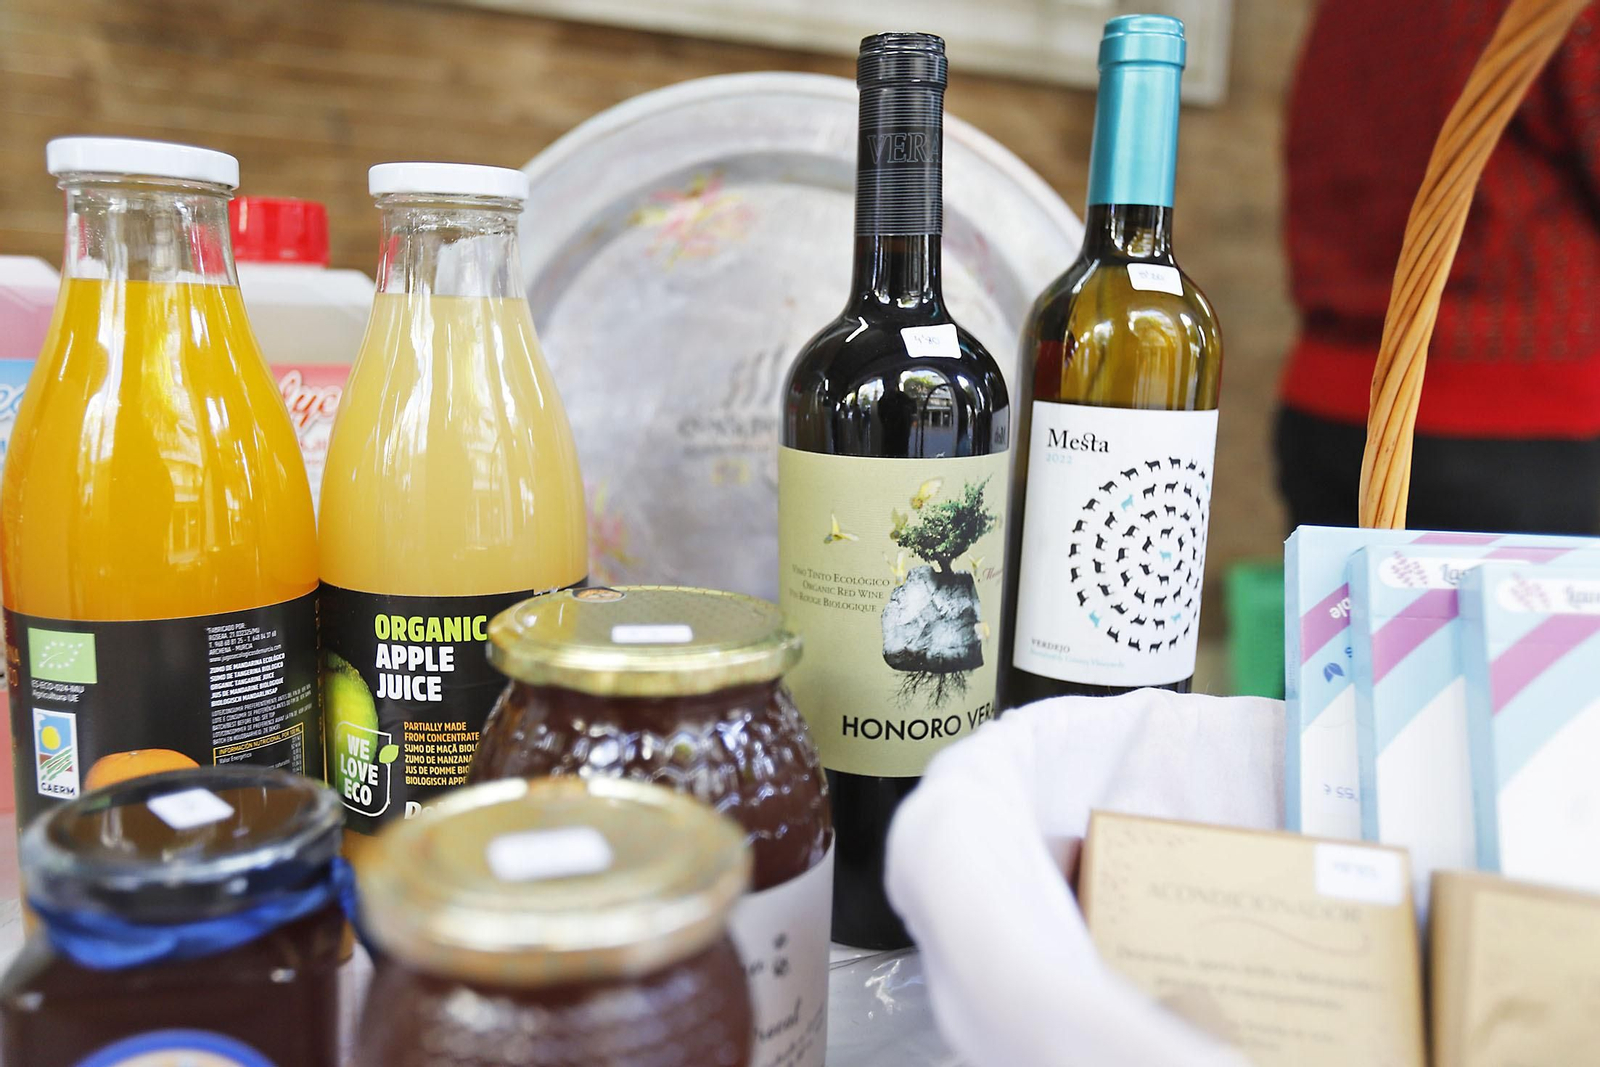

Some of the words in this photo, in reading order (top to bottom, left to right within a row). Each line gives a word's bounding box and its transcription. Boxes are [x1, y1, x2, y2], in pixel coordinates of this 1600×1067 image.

[1048, 428, 1110, 452] Mesta
[1046, 453, 1072, 464] 2022
[374, 614, 488, 642] ORGANIC
[1031, 639, 1070, 653] VERDEJO
[376, 643, 454, 672] APPLE
[210, 666, 225, 674] ZUMO
[233, 659, 262, 669] MANDARINA
[210, 681, 234, 691] ORGANIC
[262, 672, 275, 680] JUICE
[376, 673, 442, 702] JUICE
[32, 689, 68, 701] Agricultura
[404, 722, 442, 732] PARTIALLY
[444, 722, 466, 731] MADE
[842, 715, 961, 740] HONORO
[967, 702, 995, 730] VER
[219, 742, 252, 755] INFORMACIÓN
[253, 735, 282, 747] NUTRICIONAL
[404, 732, 425, 742] FROM
[427, 732, 480, 742] CONCENTRATE
[348, 734, 370, 760] WE
[405, 743, 424, 753] SUMO
[426, 745, 435, 753] DE
[436, 744, 457, 754] MAÇÃ
[405, 755, 424, 764] ZUMO
[426, 755, 436, 764] DE
[340, 753, 378, 786] LOVE
[405, 766, 417, 774] JUS
[418, 766, 428, 774] DE
[429, 766, 456, 775] POMME
[41, 782, 75, 796] CAERM
[406, 776, 447, 786] BIOLOGISCH
[344, 778, 372, 806] ECO
[1149, 880, 1362, 922] ACONDICIONADOR
